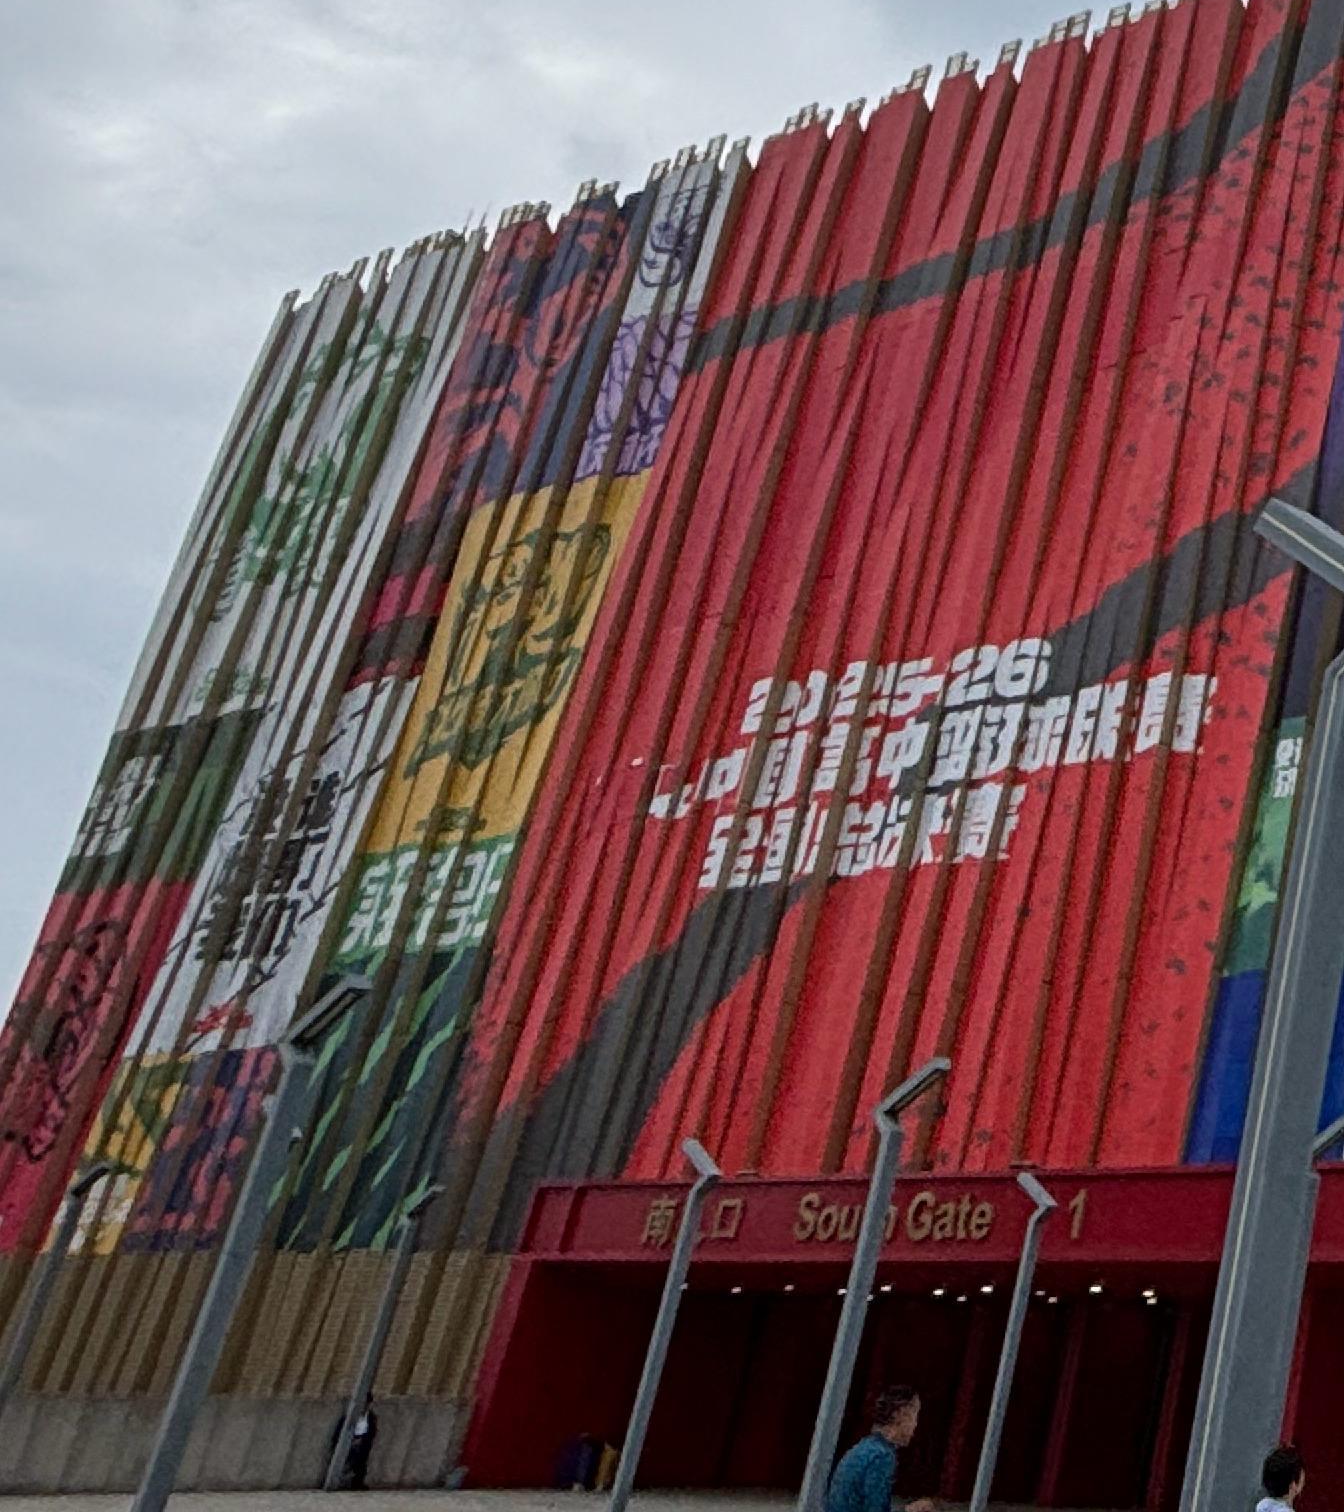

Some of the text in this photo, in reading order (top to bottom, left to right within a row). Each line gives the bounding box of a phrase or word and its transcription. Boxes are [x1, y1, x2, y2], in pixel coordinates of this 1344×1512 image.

[739, 637, 1054, 736] 2025-26
[642, 1192, 746, 1248] 南口
[796, 1188, 1088, 1243] Souh Gate 1
